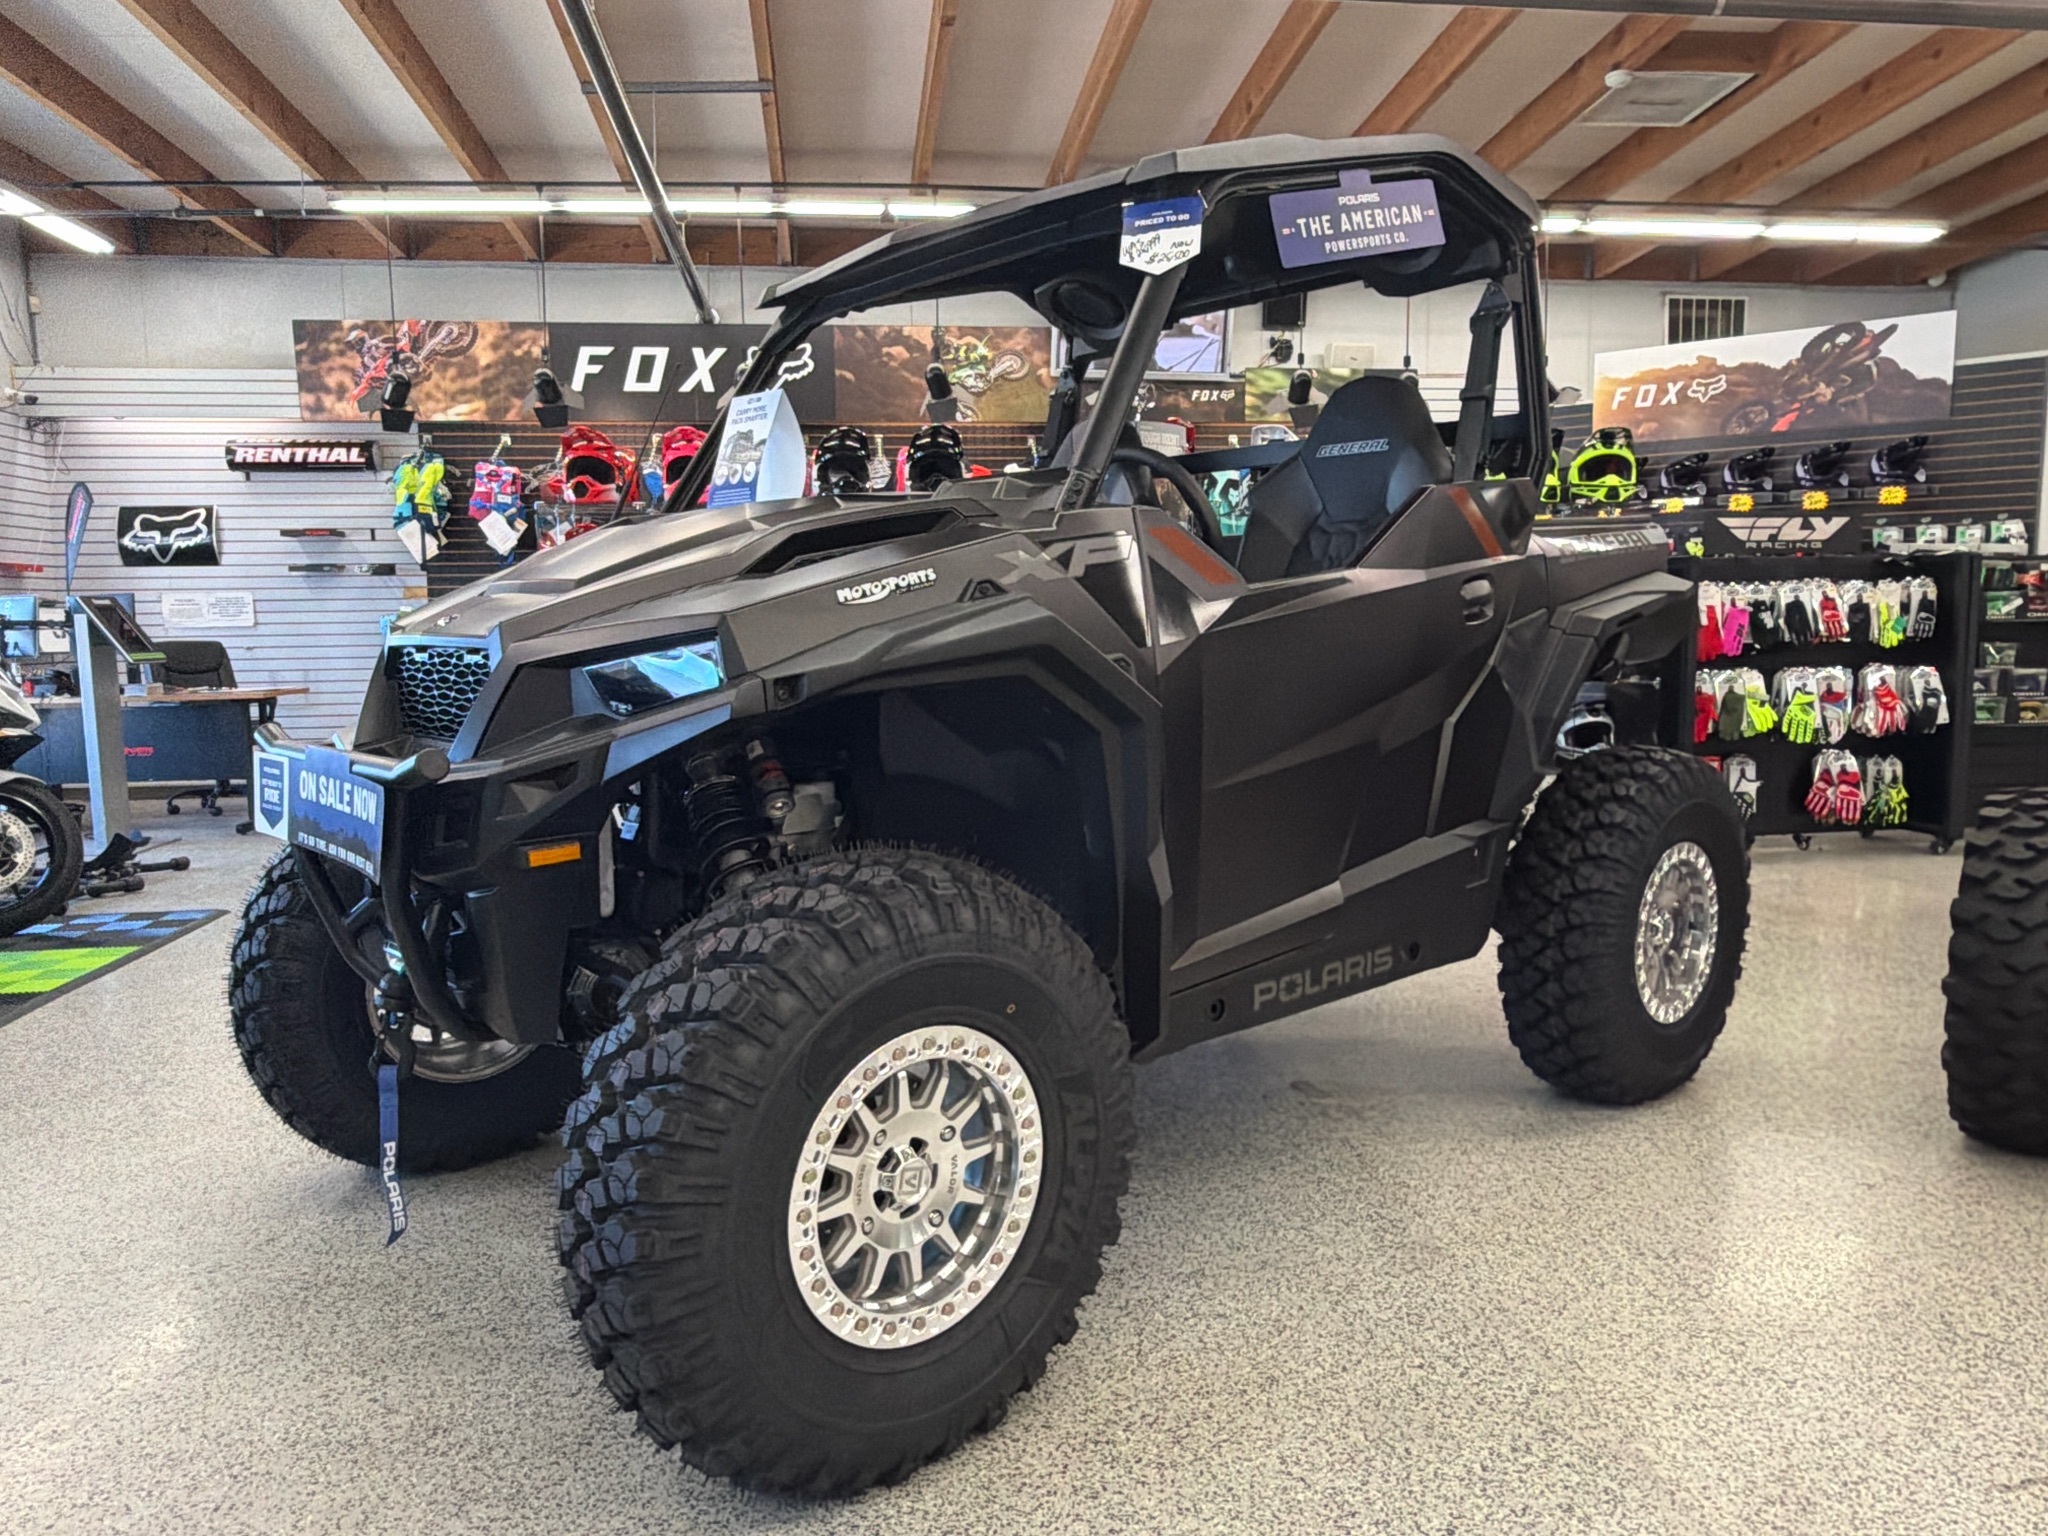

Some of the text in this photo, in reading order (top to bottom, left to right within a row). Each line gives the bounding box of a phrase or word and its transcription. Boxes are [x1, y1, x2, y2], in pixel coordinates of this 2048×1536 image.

[1337, 192, 1381, 206] POLARIS
[1134, 216, 1164, 227] PRICED
[1165, 214, 1177, 222] TO
[1296, 204, 1423, 239] THE AMERICAN
[1324, 231, 1410, 254] POWERSPORTS CO.
[570, 346, 728, 393] FOX
[1191, 389, 1219, 402] FOX
[1611, 380, 1685, 411] FOX
[234, 447, 367, 463] RENTHAL
[1315, 438, 1389, 458] GENERAL
[1717, 517, 1851, 541] FLY
[994, 535, 1133, 585] XP
[1745, 541, 1822, 549] RACING
[836, 568, 937, 604] MOTOSPORTS
[299, 769, 377, 825] ON SALE NOW
[1253, 945, 1393, 1011] POLARIS
[382, 1141, 406, 1232] POLARIS
[946, 1154, 959, 1194] VALOR
